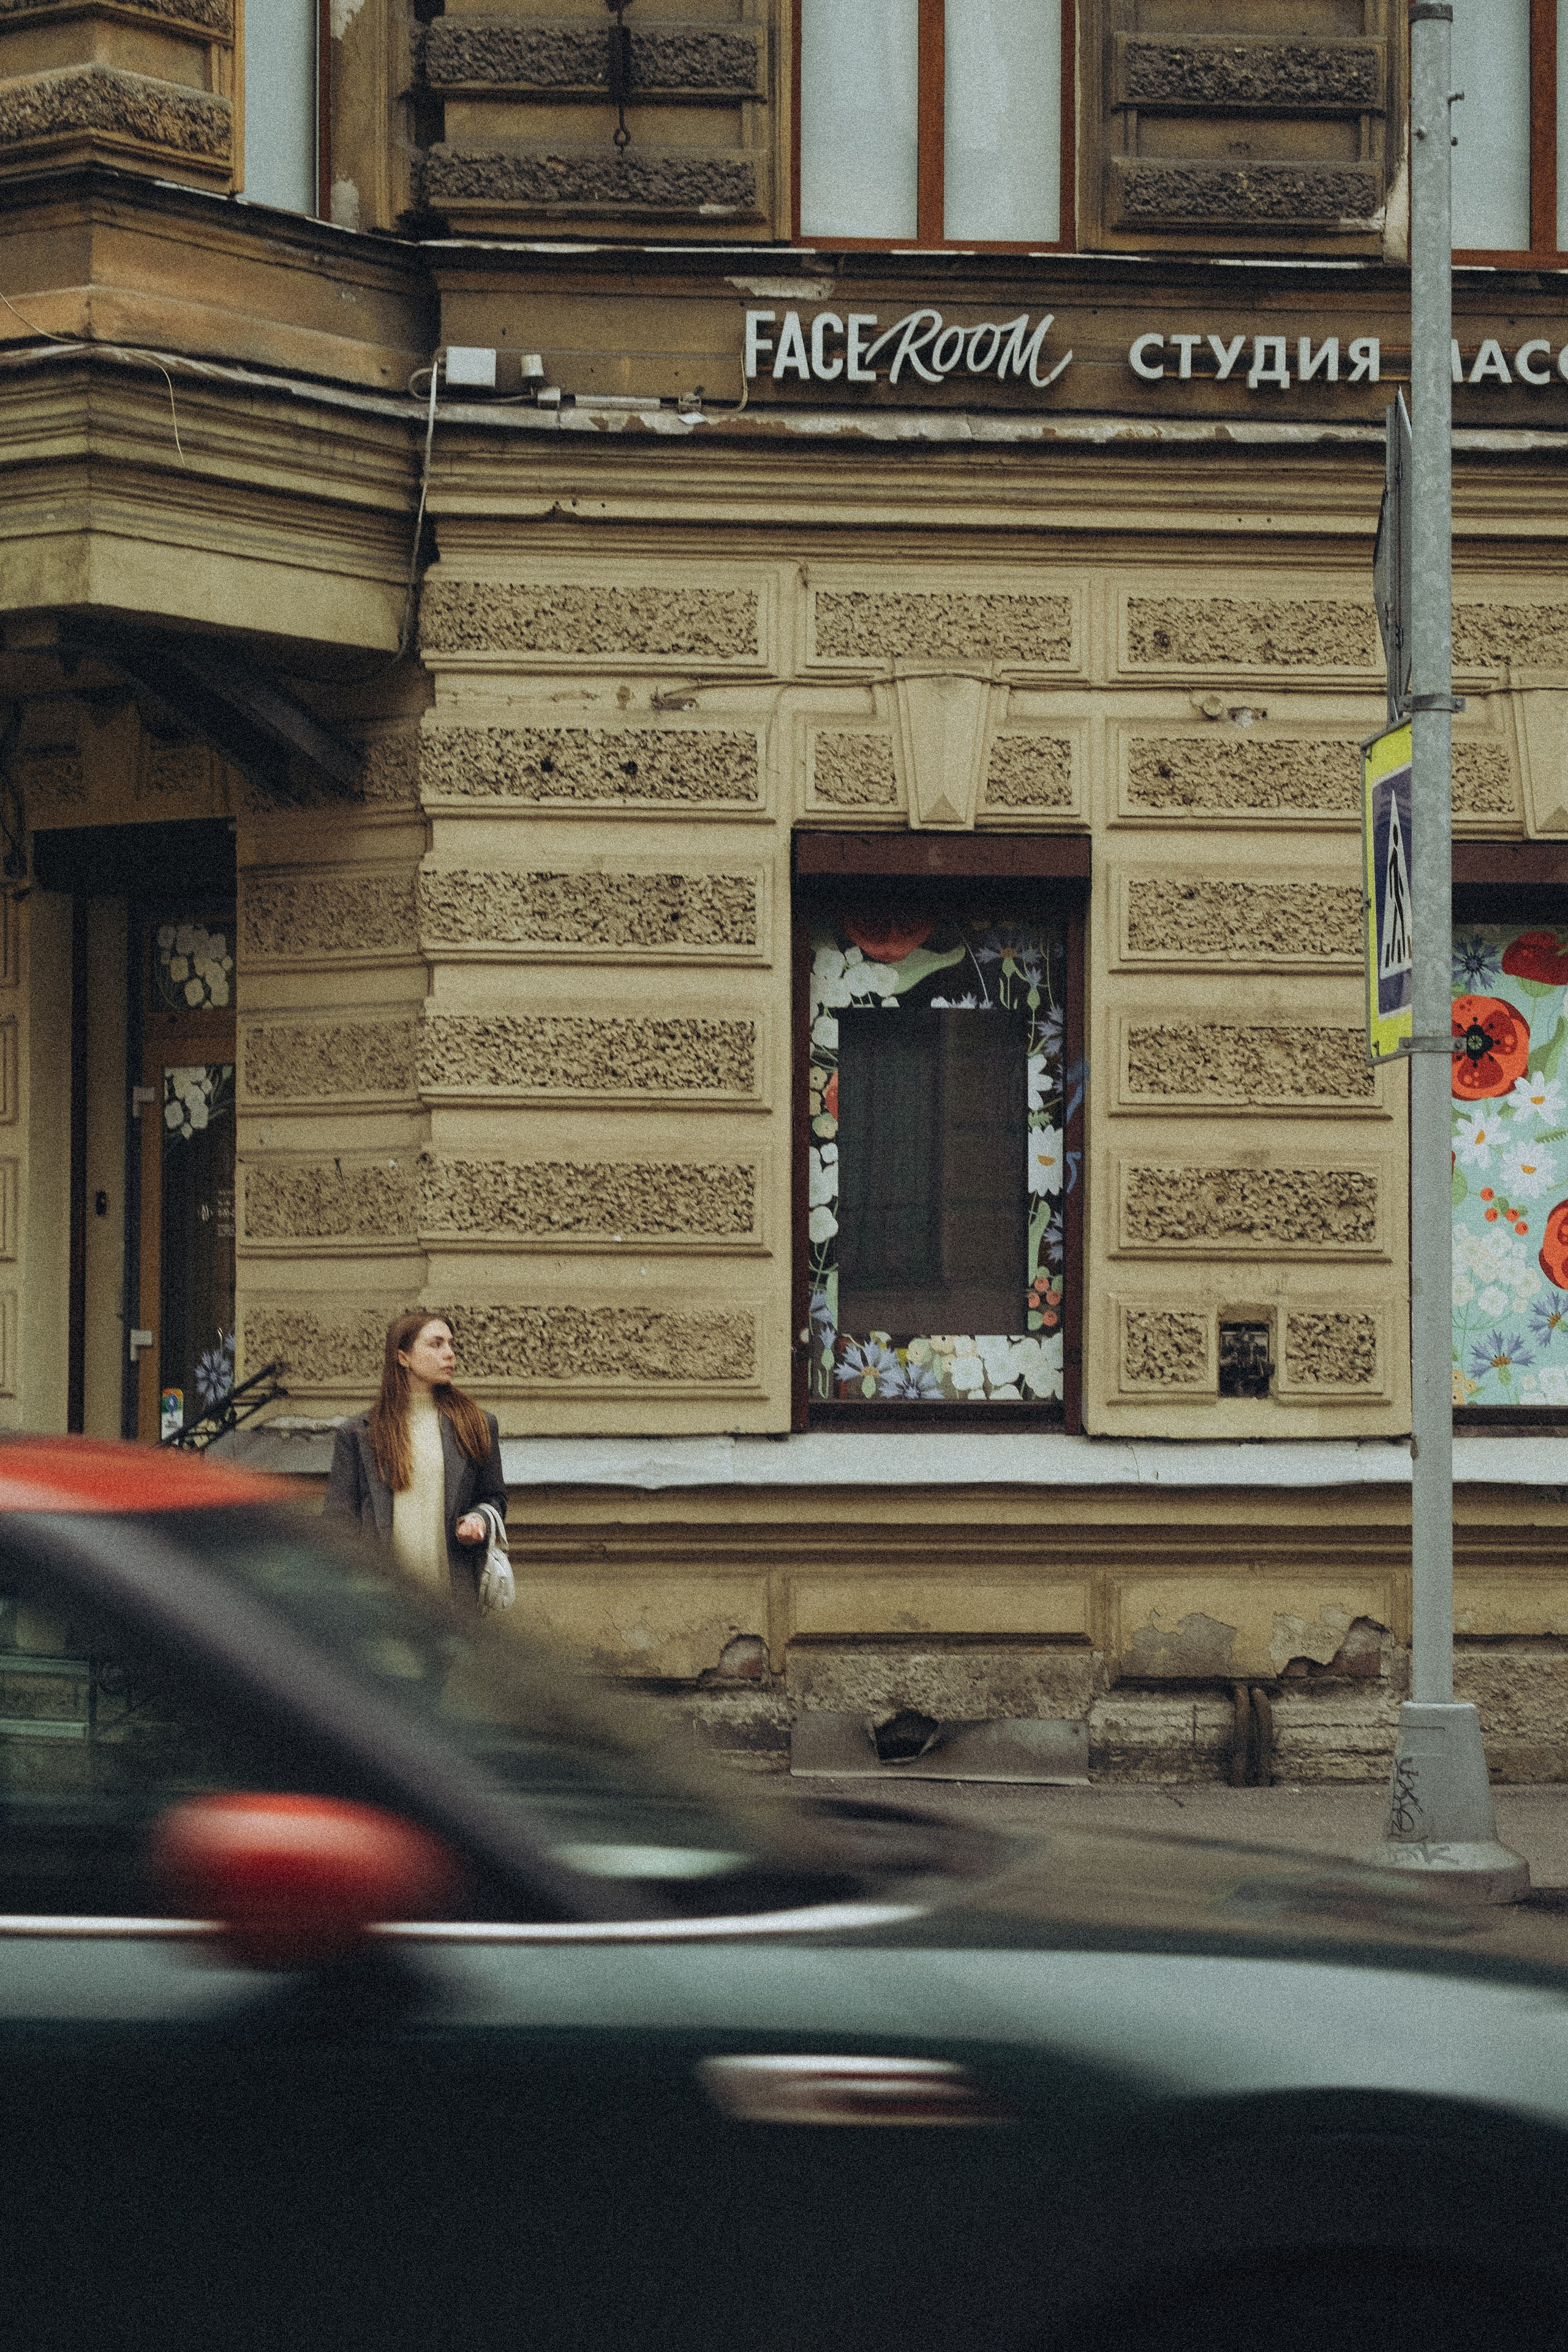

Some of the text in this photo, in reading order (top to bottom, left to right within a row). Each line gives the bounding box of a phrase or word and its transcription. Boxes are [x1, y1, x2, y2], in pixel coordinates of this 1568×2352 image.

[745, 309, 878, 381] FACE
[1129, 333, 1568, 389] СТУДИЯ АС
